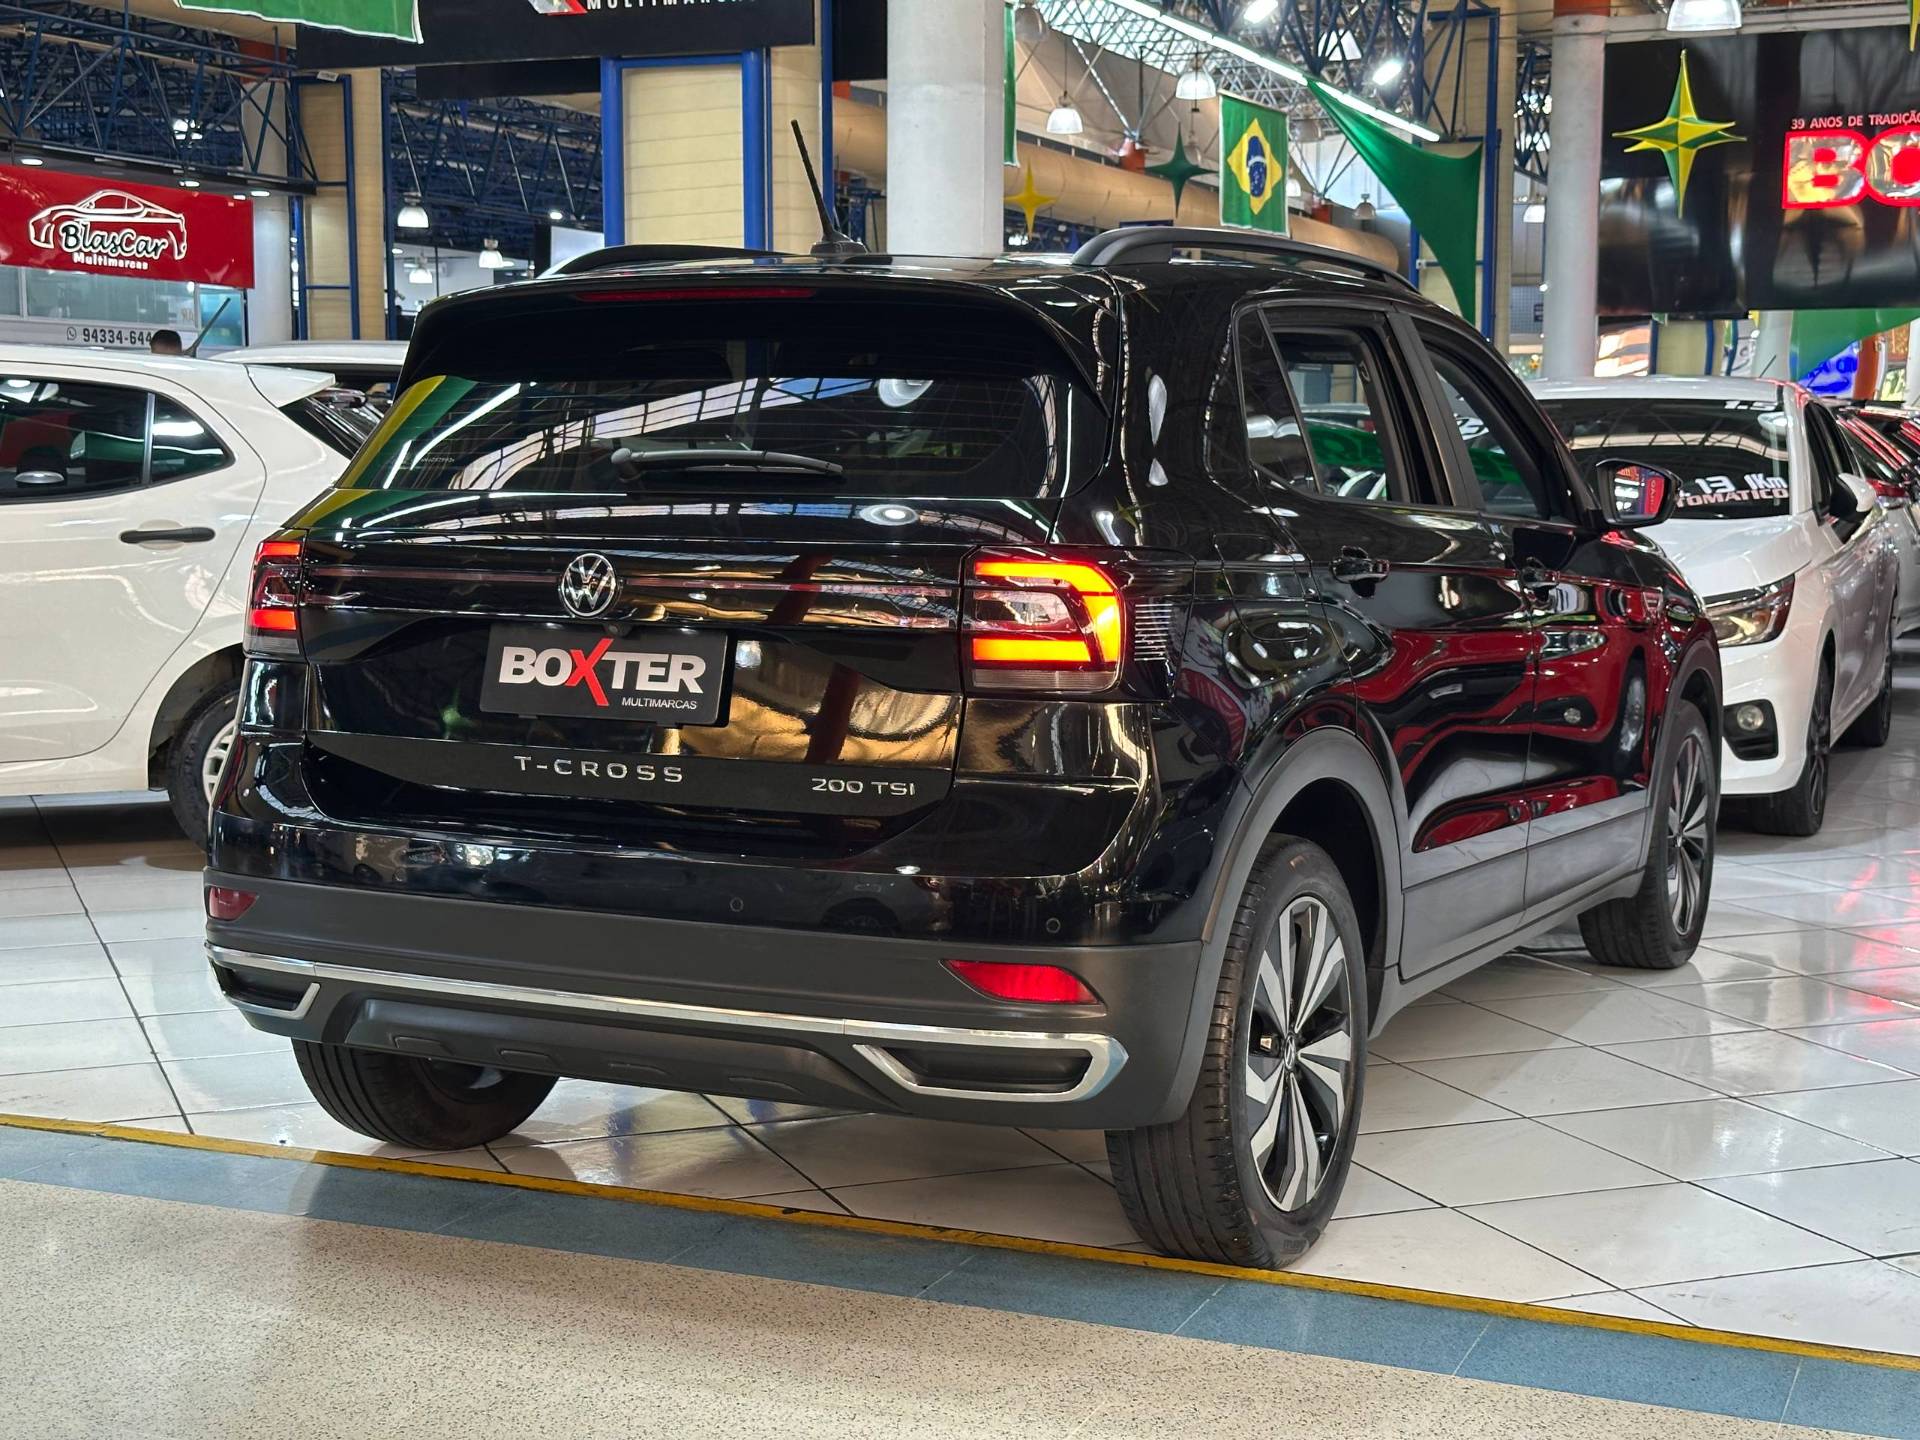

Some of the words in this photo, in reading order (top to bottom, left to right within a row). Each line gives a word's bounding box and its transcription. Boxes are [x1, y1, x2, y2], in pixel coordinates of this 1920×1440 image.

[1791, 118, 1805, 130] 39
[1810, 116, 1842, 129] ANOS
[1848, 115, 1863, 127] DE
[60, 222, 168, 259] BlasCar
[73, 252, 149, 270] Multimarcas
[83, 327, 153, 345] 94334-644
[1676, 488, 1789, 508] TOMATICO
[498, 638, 706, 707] BOXTER
[621, 697, 697, 710] MULTIMARCAS
[514, 755, 684, 783] T-CROSS
[811, 777, 864, 794] 200
[871, 780, 916, 796] TSI
